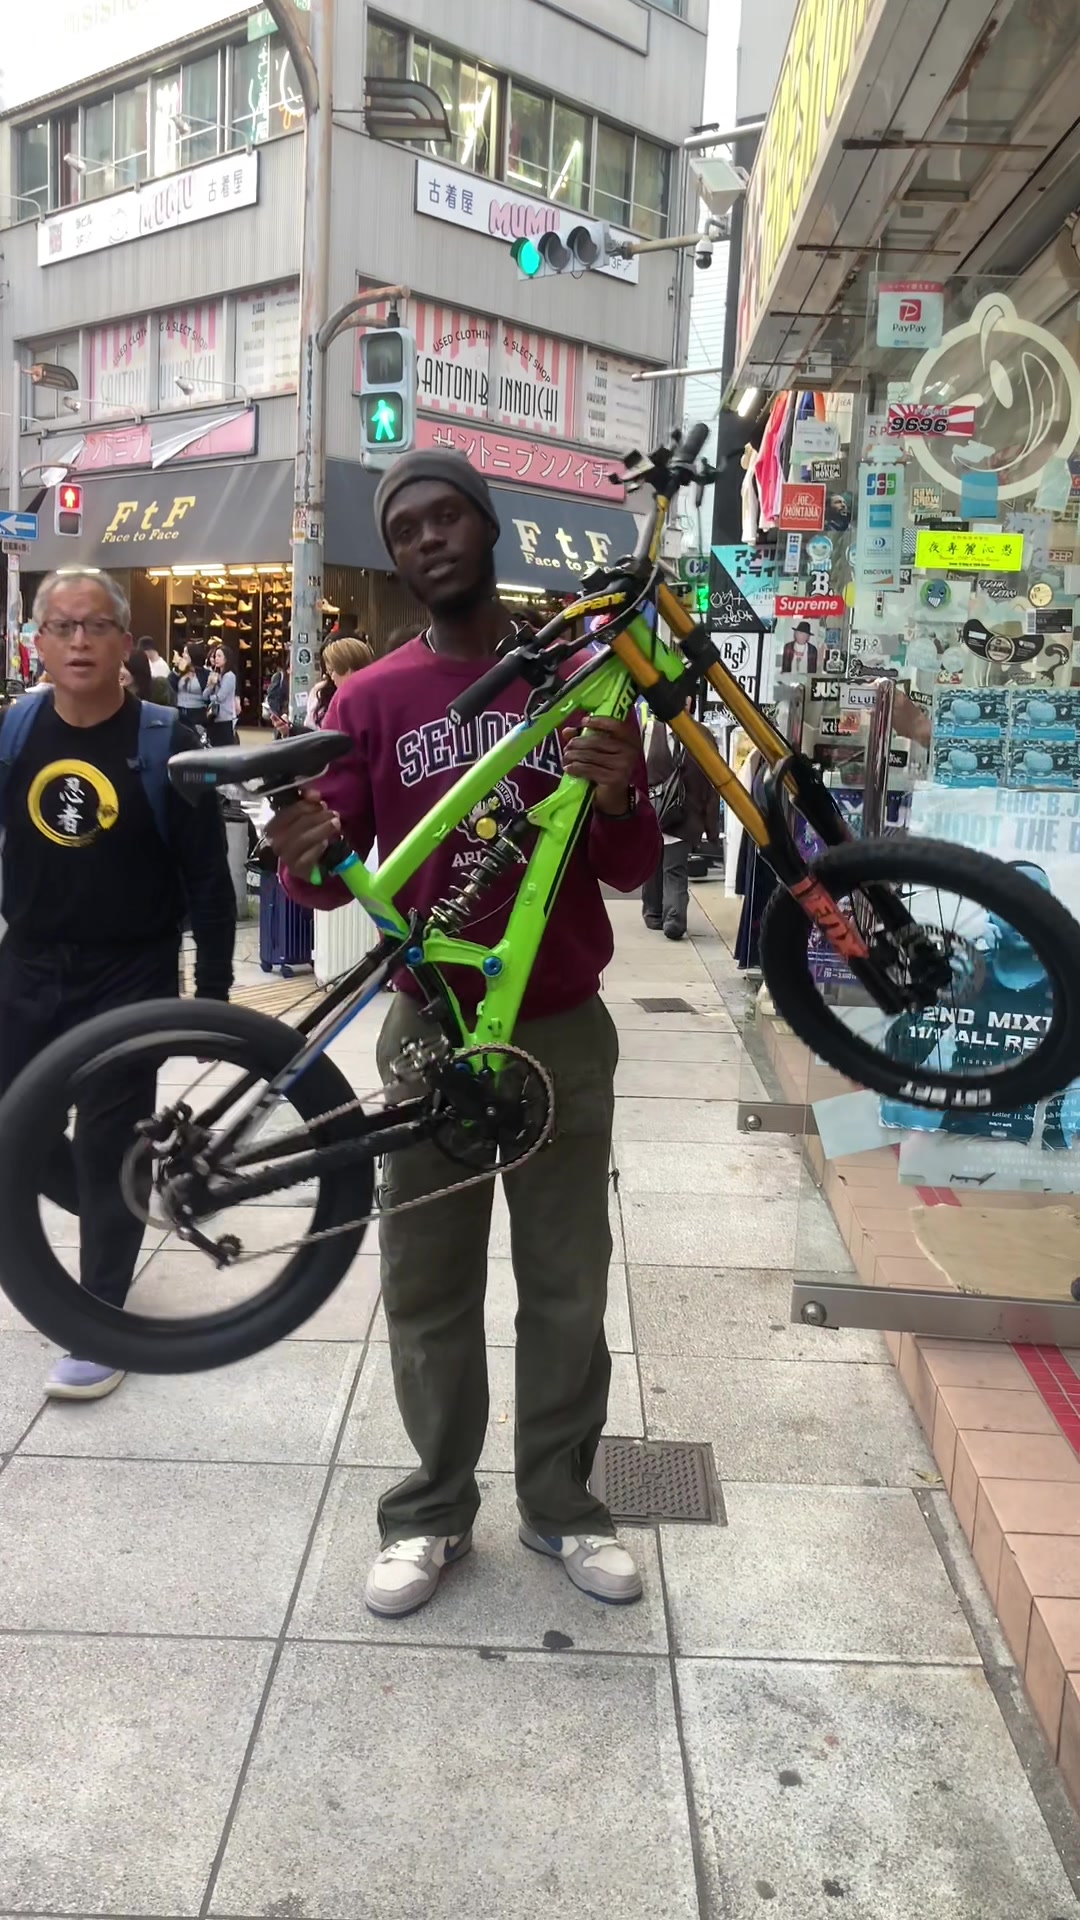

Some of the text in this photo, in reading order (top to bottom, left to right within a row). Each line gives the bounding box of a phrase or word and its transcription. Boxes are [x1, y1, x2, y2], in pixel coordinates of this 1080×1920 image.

[208, 168, 243, 202] 古着屋
[428, 178, 473, 216] 古着屋
[611, 257, 622, 269] 3F
[892, 323, 927, 334] PayPay
[112, 342, 128, 367] USED
[172, 321, 192, 338] SLECT
[191, 330, 208, 351] SHOP
[433, 333, 454, 353] USED
[502, 336, 509, 347] &
[511, 340, 533, 362] SLECT
[533, 359, 551, 383] SHOP
[890, 416, 948, 433] 9696
[797, 495, 809, 505] JOE
[784, 506, 819, 517] MONTANA
[101, 529, 179, 543] Face to Face
[523, 550, 560, 568] Face
[565, 557, 582, 571] to
[1049, 551, 1073, 561] DEEP
[779, 597, 838, 614] Supreme
[56, 776, 85, 834] 忍者
[1014, 817, 1059, 852] THE
[923, 1006, 1053, 1032] 2ND MIXT
[955, 1030, 999, 1047] ALL
[1005, 1034, 1041, 1051] RE
